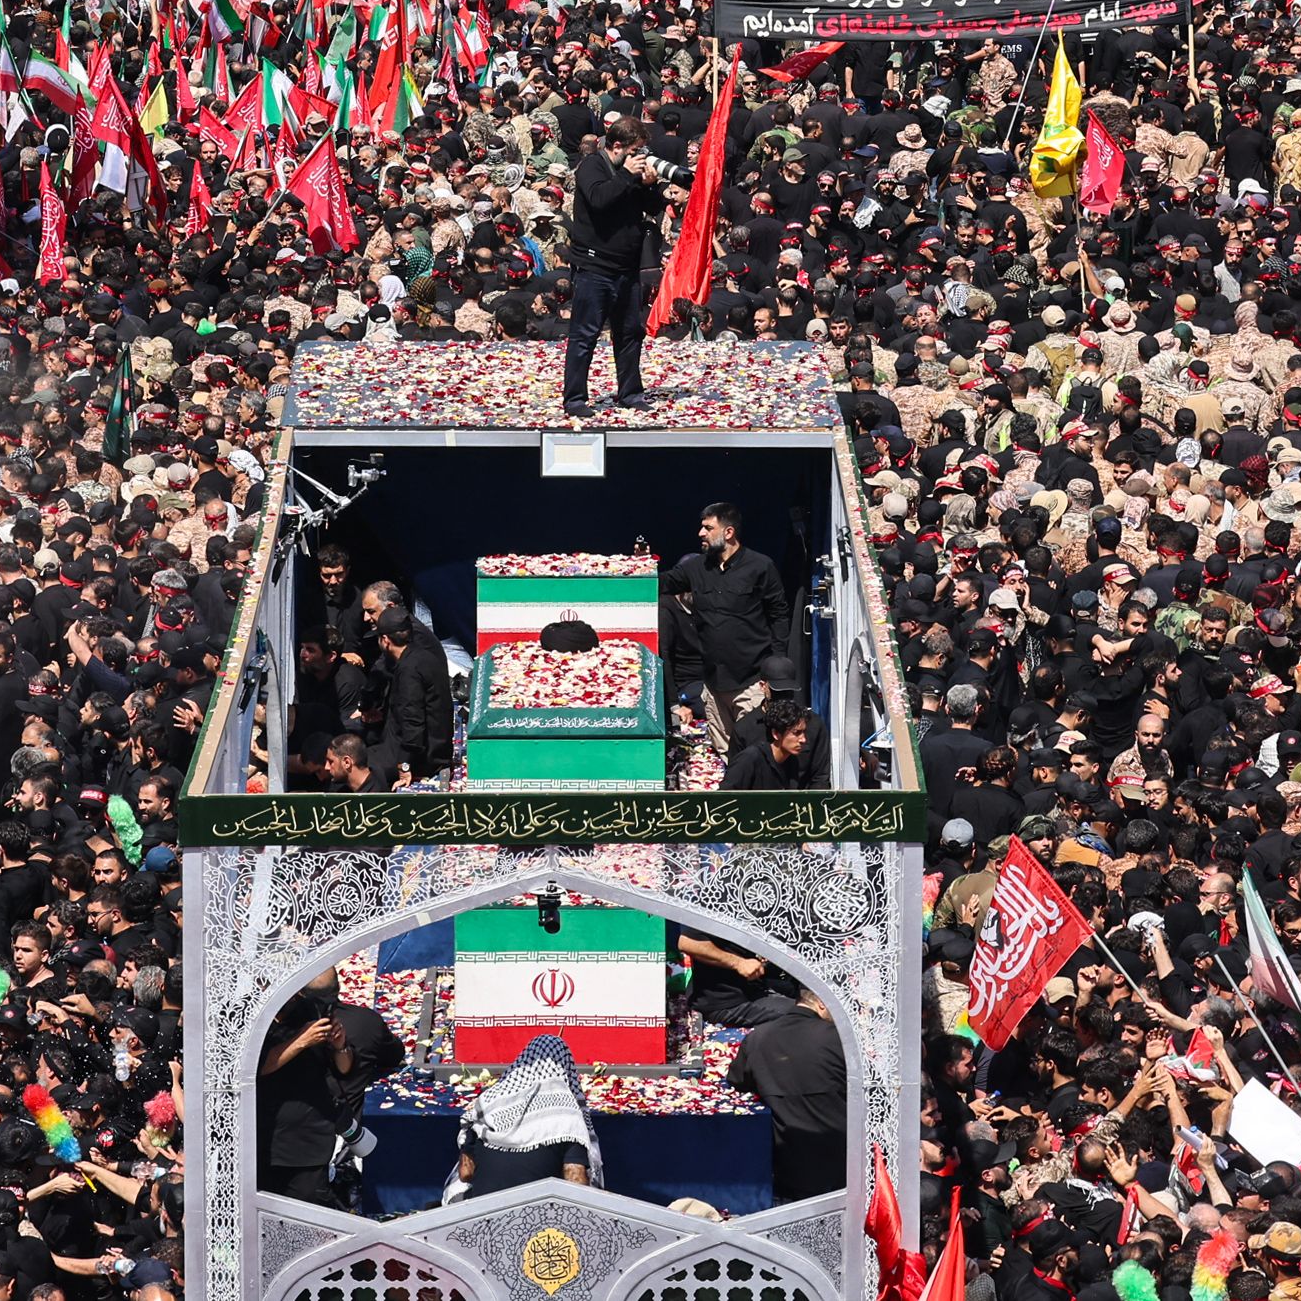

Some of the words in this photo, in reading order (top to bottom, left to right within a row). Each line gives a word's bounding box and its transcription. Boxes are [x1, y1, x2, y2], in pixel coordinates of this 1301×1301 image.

[916, 9, 997, 39] حسینی
[996, 8, 1034, 36] علی
[1084, 0, 1120, 28] امام
[1001, 44, 1023, 54] EMS
